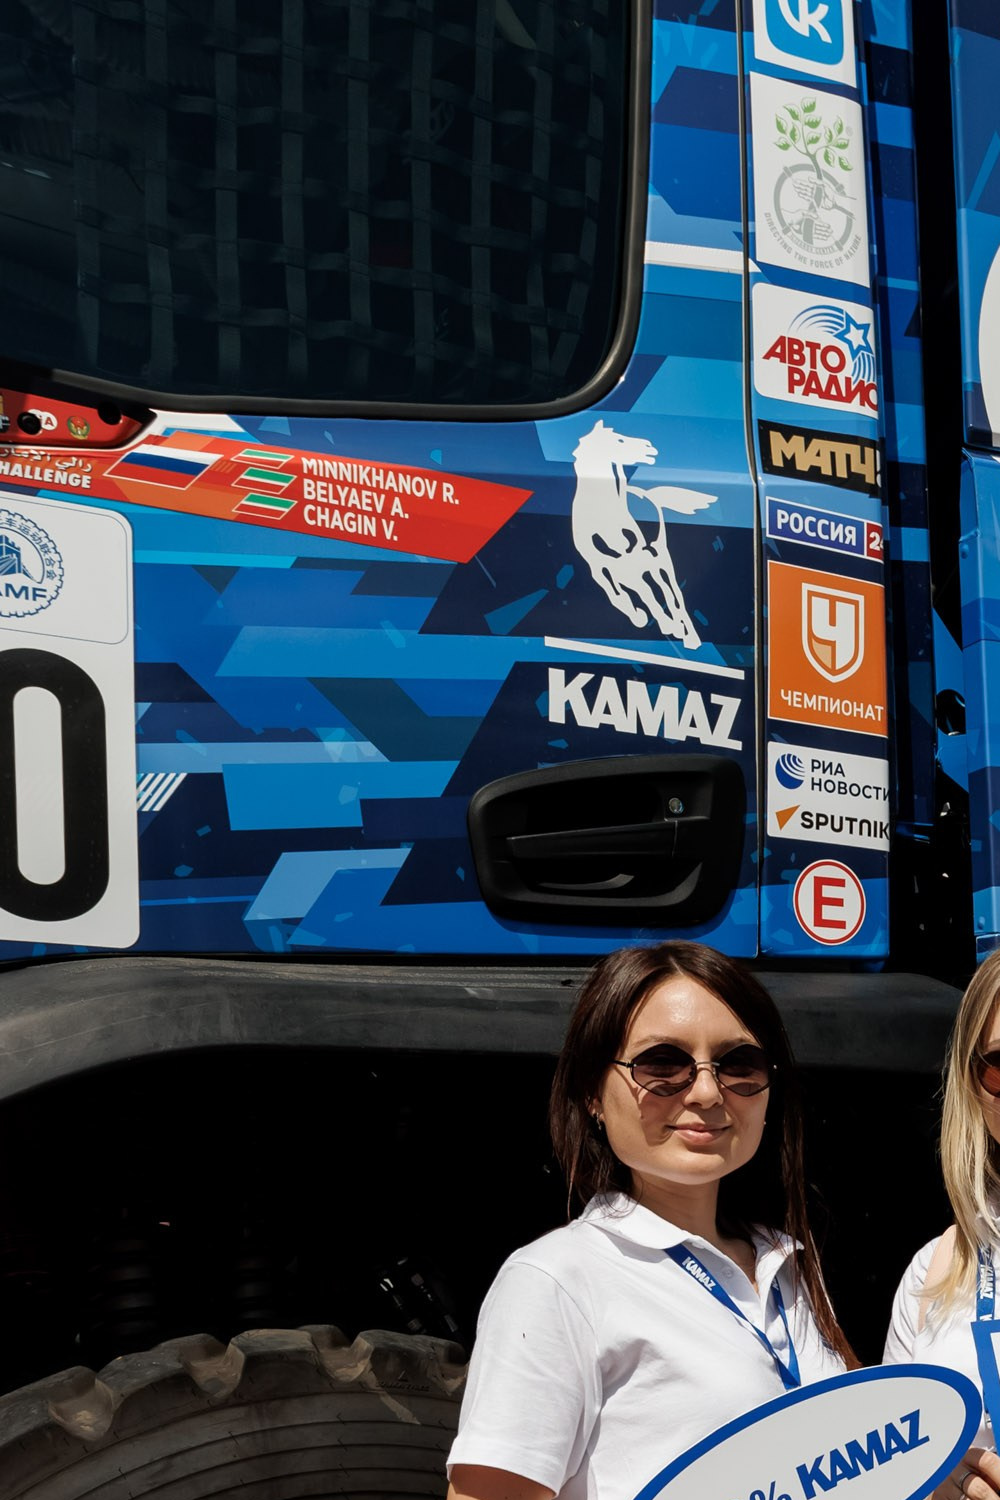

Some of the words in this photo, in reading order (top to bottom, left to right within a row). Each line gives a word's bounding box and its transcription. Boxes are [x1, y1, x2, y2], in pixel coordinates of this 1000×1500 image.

[762, 335, 846, 374] АВТО
[301, 457, 437, 500] MINNIKHANOV
[442, 482, 460, 505] R.
[303, 478, 385, 514] BELYAEV
[390, 496, 410, 519] A.
[303, 504, 377, 538] CHAGIN
[381, 518, 399, 542] V.
[776, 509, 857, 547] РОССИЯ
[0, 583, 47, 601] MF
[548, 667, 743, 751] KAMAZ
[780, 688, 884, 722] ЧЕМПИОНАТ
[811, 759, 846, 778] РИА
[800, 811, 889, 841] SPUTNIK
[813, 875, 847, 930] E
[681, 1256, 717, 1291] KAMAZ
[795, 1408, 931, 1500] KAMAZ
